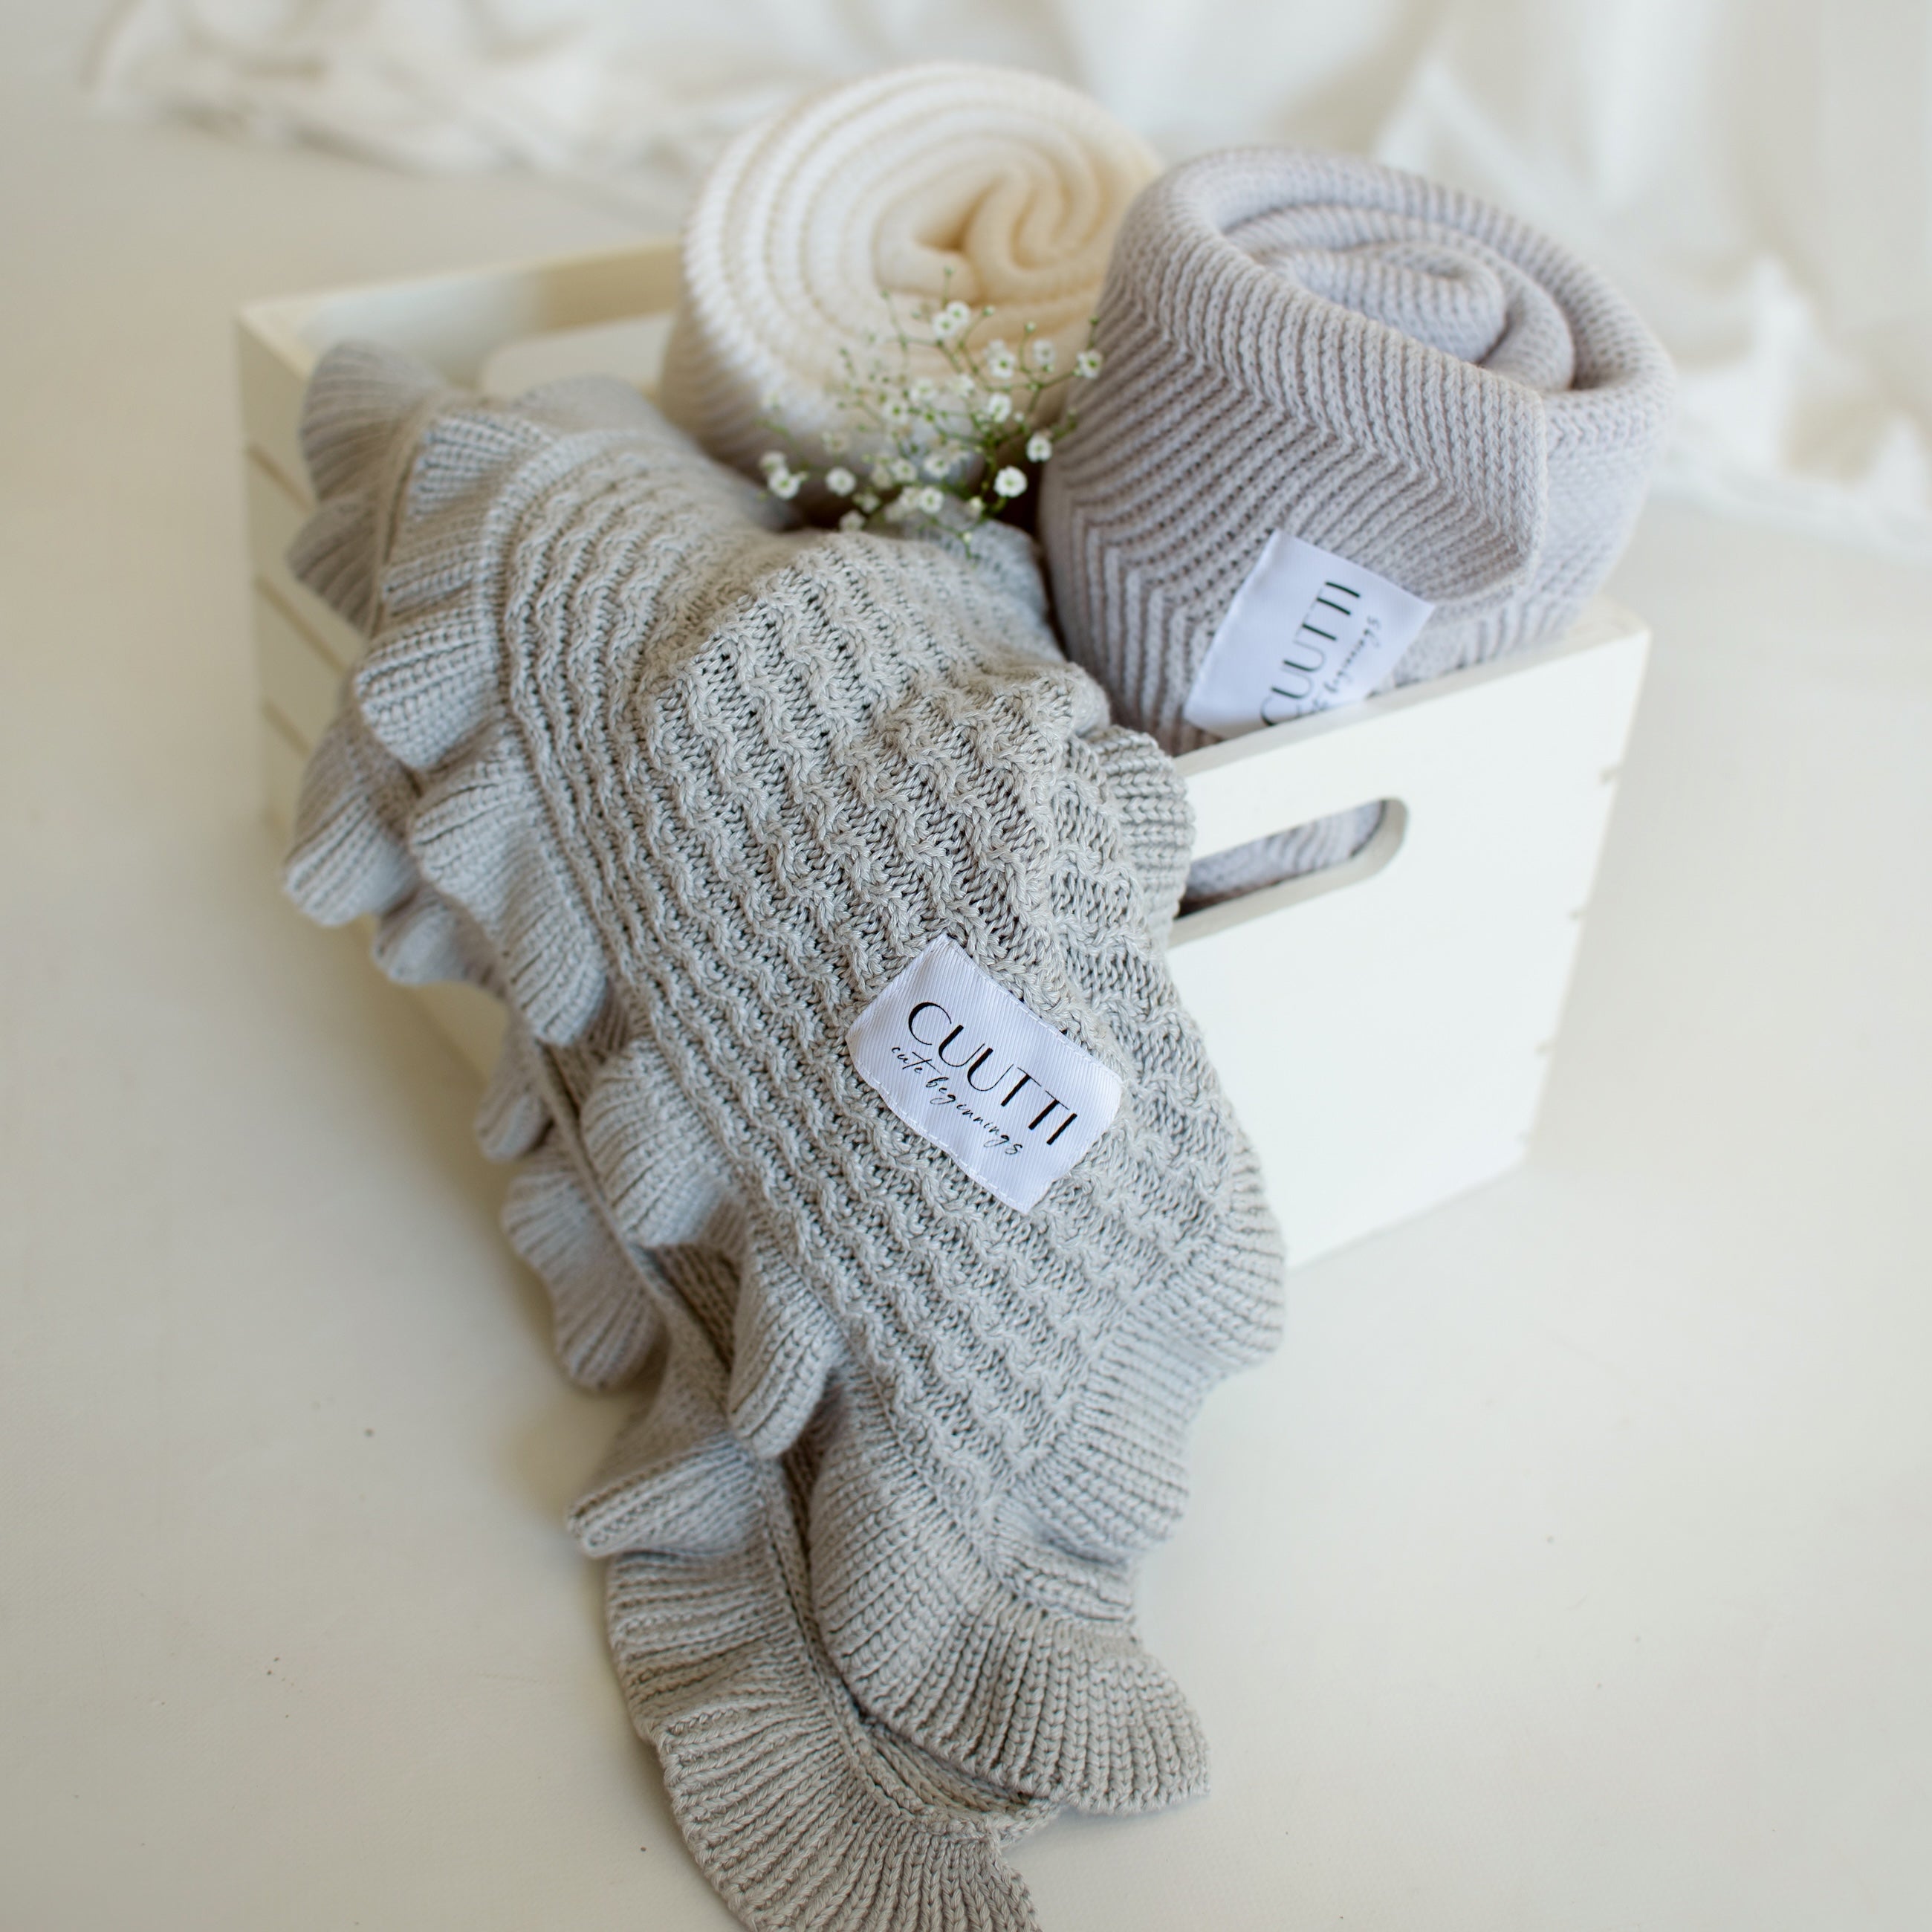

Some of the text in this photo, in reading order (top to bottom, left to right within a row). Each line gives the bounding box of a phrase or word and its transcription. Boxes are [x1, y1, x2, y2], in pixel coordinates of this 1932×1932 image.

[1260, 580, 1361, 726] CUUTTI
[891, 1046, 1023, 1155] cute beginnings
[907, 1001, 1078, 1145] CUUTTI
